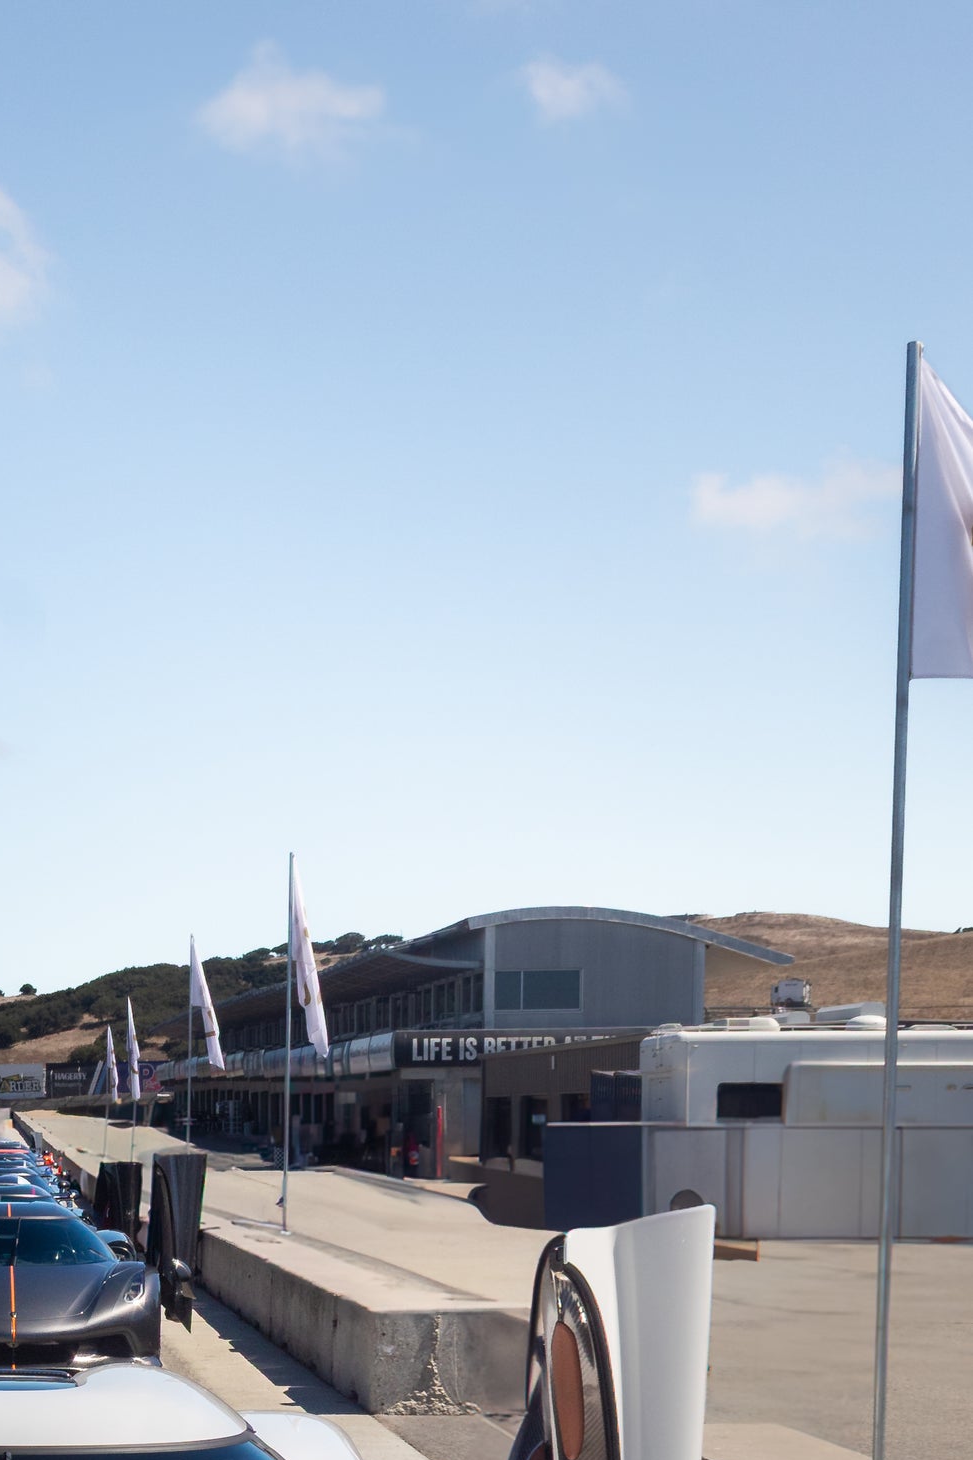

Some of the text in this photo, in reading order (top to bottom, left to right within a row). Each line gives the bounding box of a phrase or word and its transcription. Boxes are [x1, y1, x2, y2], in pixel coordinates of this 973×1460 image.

[412, 1037, 453, 1061] LIFE
[459, 1037, 478, 1061] IS
[54, 1072, 87, 1080] HAGERTY
